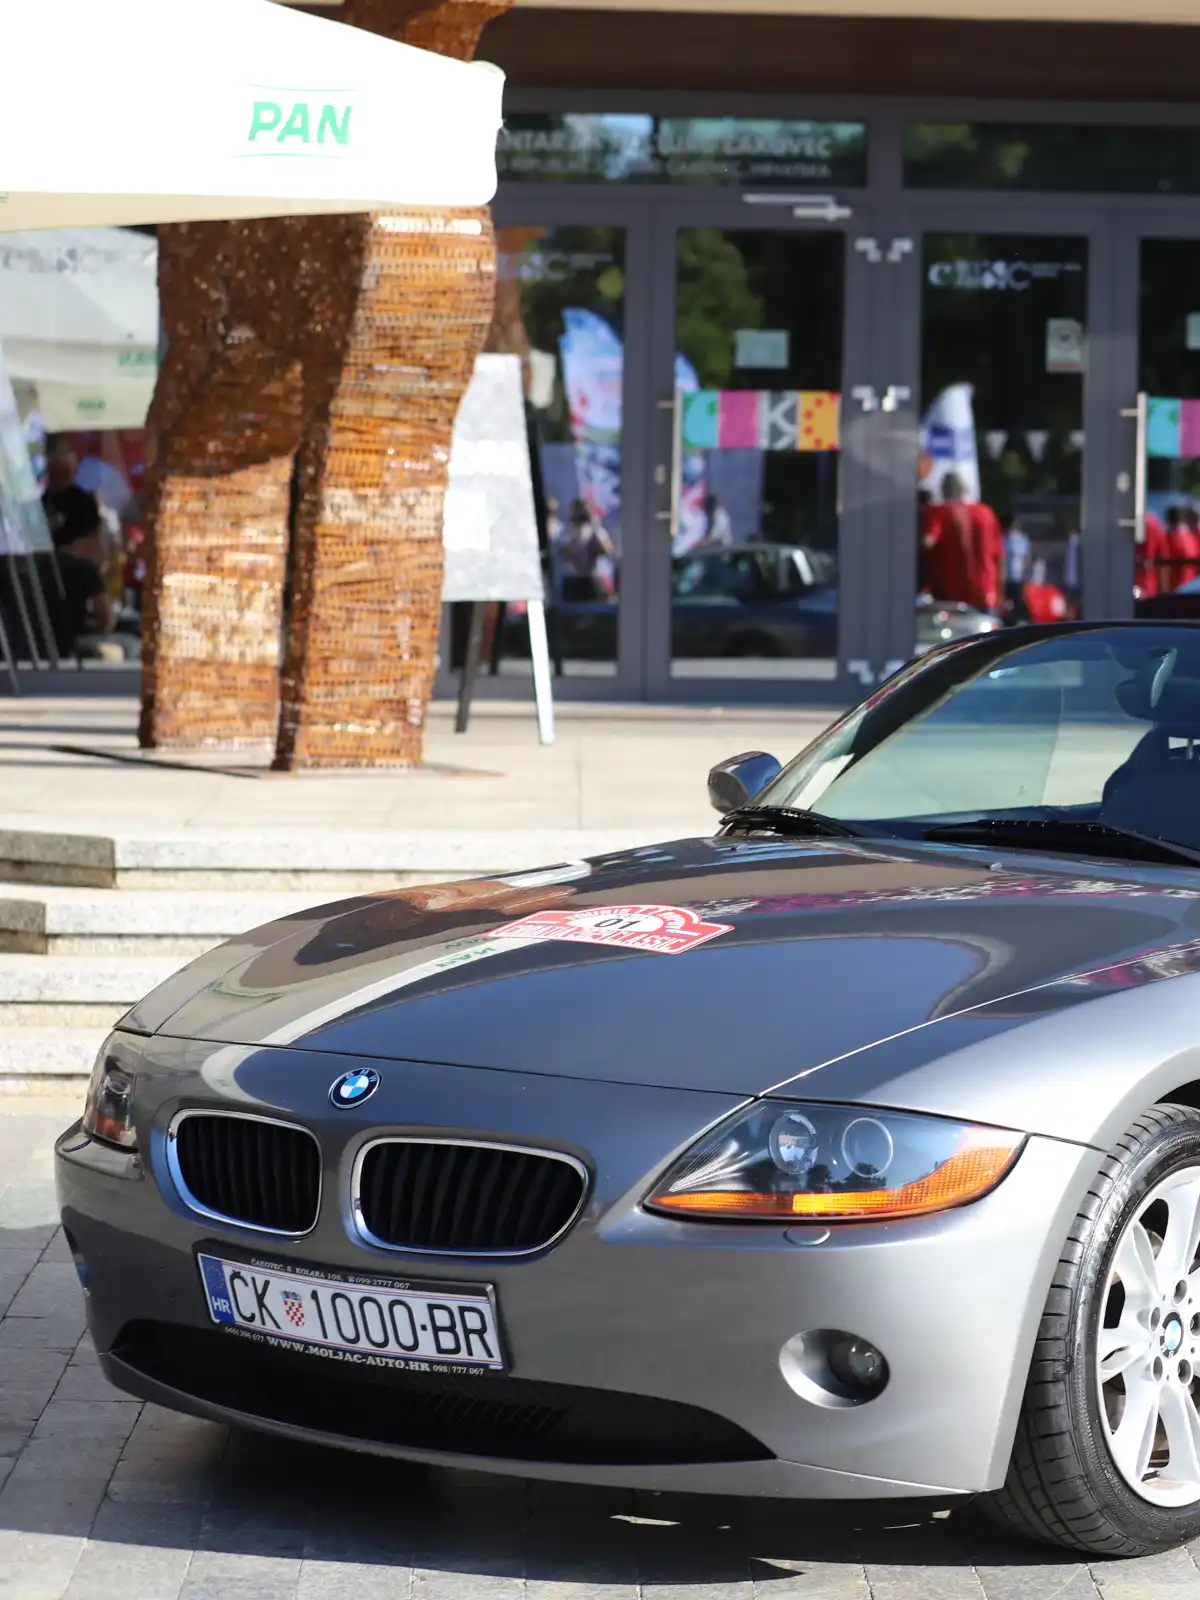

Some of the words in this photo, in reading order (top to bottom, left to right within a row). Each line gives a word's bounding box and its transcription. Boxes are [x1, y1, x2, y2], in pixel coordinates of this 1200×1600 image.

[247, 101, 353, 145] PAN
[593, 918, 641, 930] 01
[295, 1267, 326, 1279] KOLARA
[211, 1295, 231, 1315] HR
[265, 1335, 432, 1372] WWW.MOLJAC-AUTO.HR
